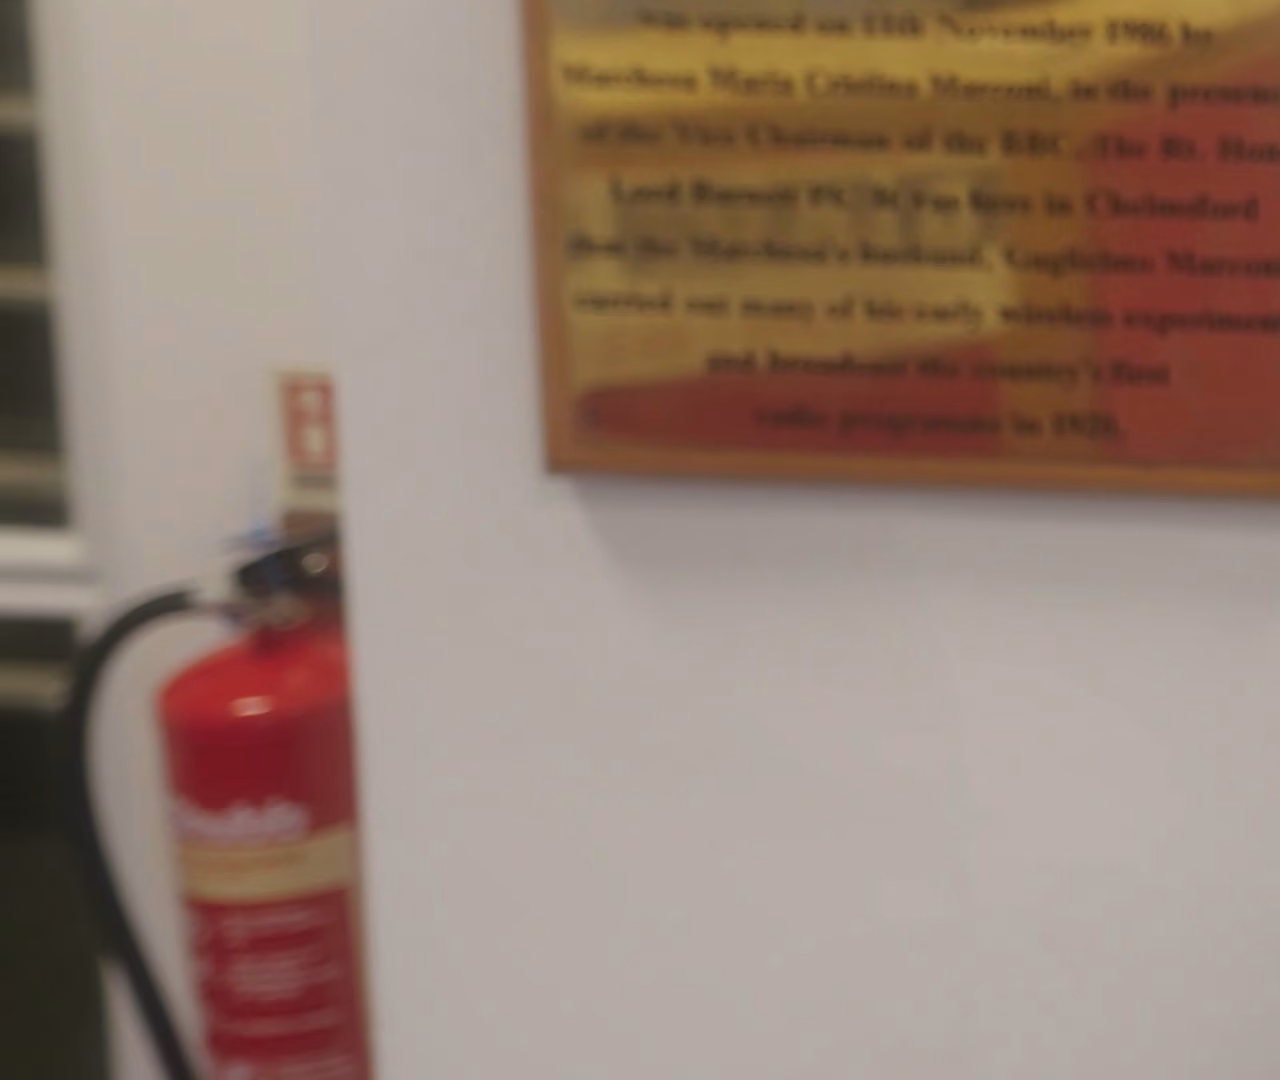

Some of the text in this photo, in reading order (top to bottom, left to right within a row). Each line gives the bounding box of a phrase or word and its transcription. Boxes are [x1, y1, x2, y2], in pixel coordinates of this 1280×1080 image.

[936, 14, 1093, 44] November
[705, 67, 795, 96] Maria
[1104, 77, 1153, 104] the
[941, 130, 990, 155] the
[1084, 187, 1260, 224] Chelmsford
